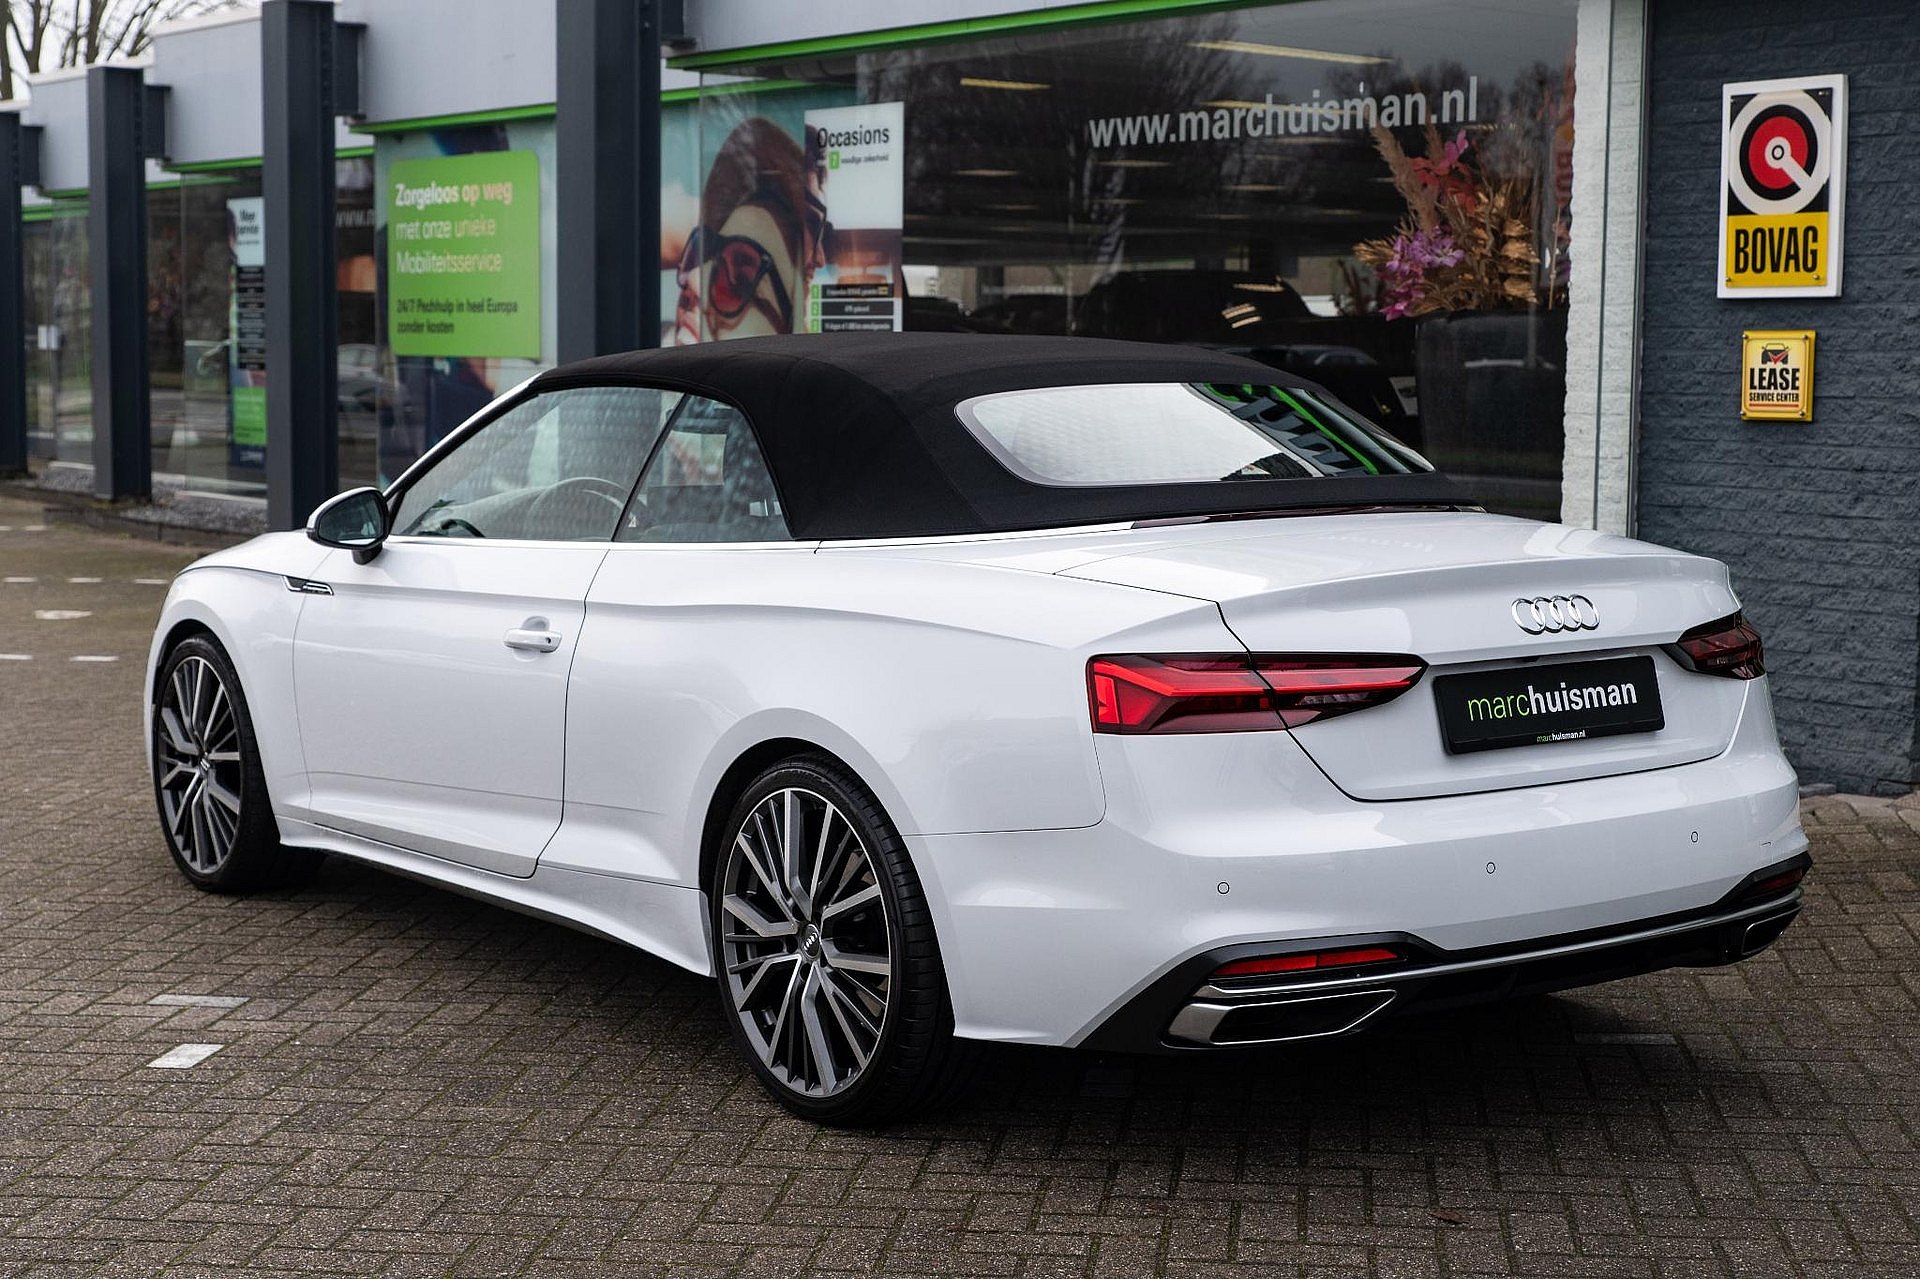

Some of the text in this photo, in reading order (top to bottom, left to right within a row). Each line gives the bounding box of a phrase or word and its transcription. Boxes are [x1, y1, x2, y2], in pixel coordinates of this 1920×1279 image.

[1089, 76, 1477, 147] www.marchuisman.nl
[817, 124, 890, 148] Occasions
[395, 181, 513, 210] Zorgeloos op weg
[396, 216, 496, 240] met onze unieke
[396, 250, 503, 274] Mobiliteitsservice
[1734, 226, 1818, 274] BOVAG
[466, 298, 485, 313] heel
[486, 298, 518, 315] Europa
[1749, 368, 1800, 390] LEASE
[1749, 392, 1800, 402] SERVICE CENTER
[1467, 682, 1638, 722] marchuisman
[1536, 729, 1586, 743] marchuisman.nl
